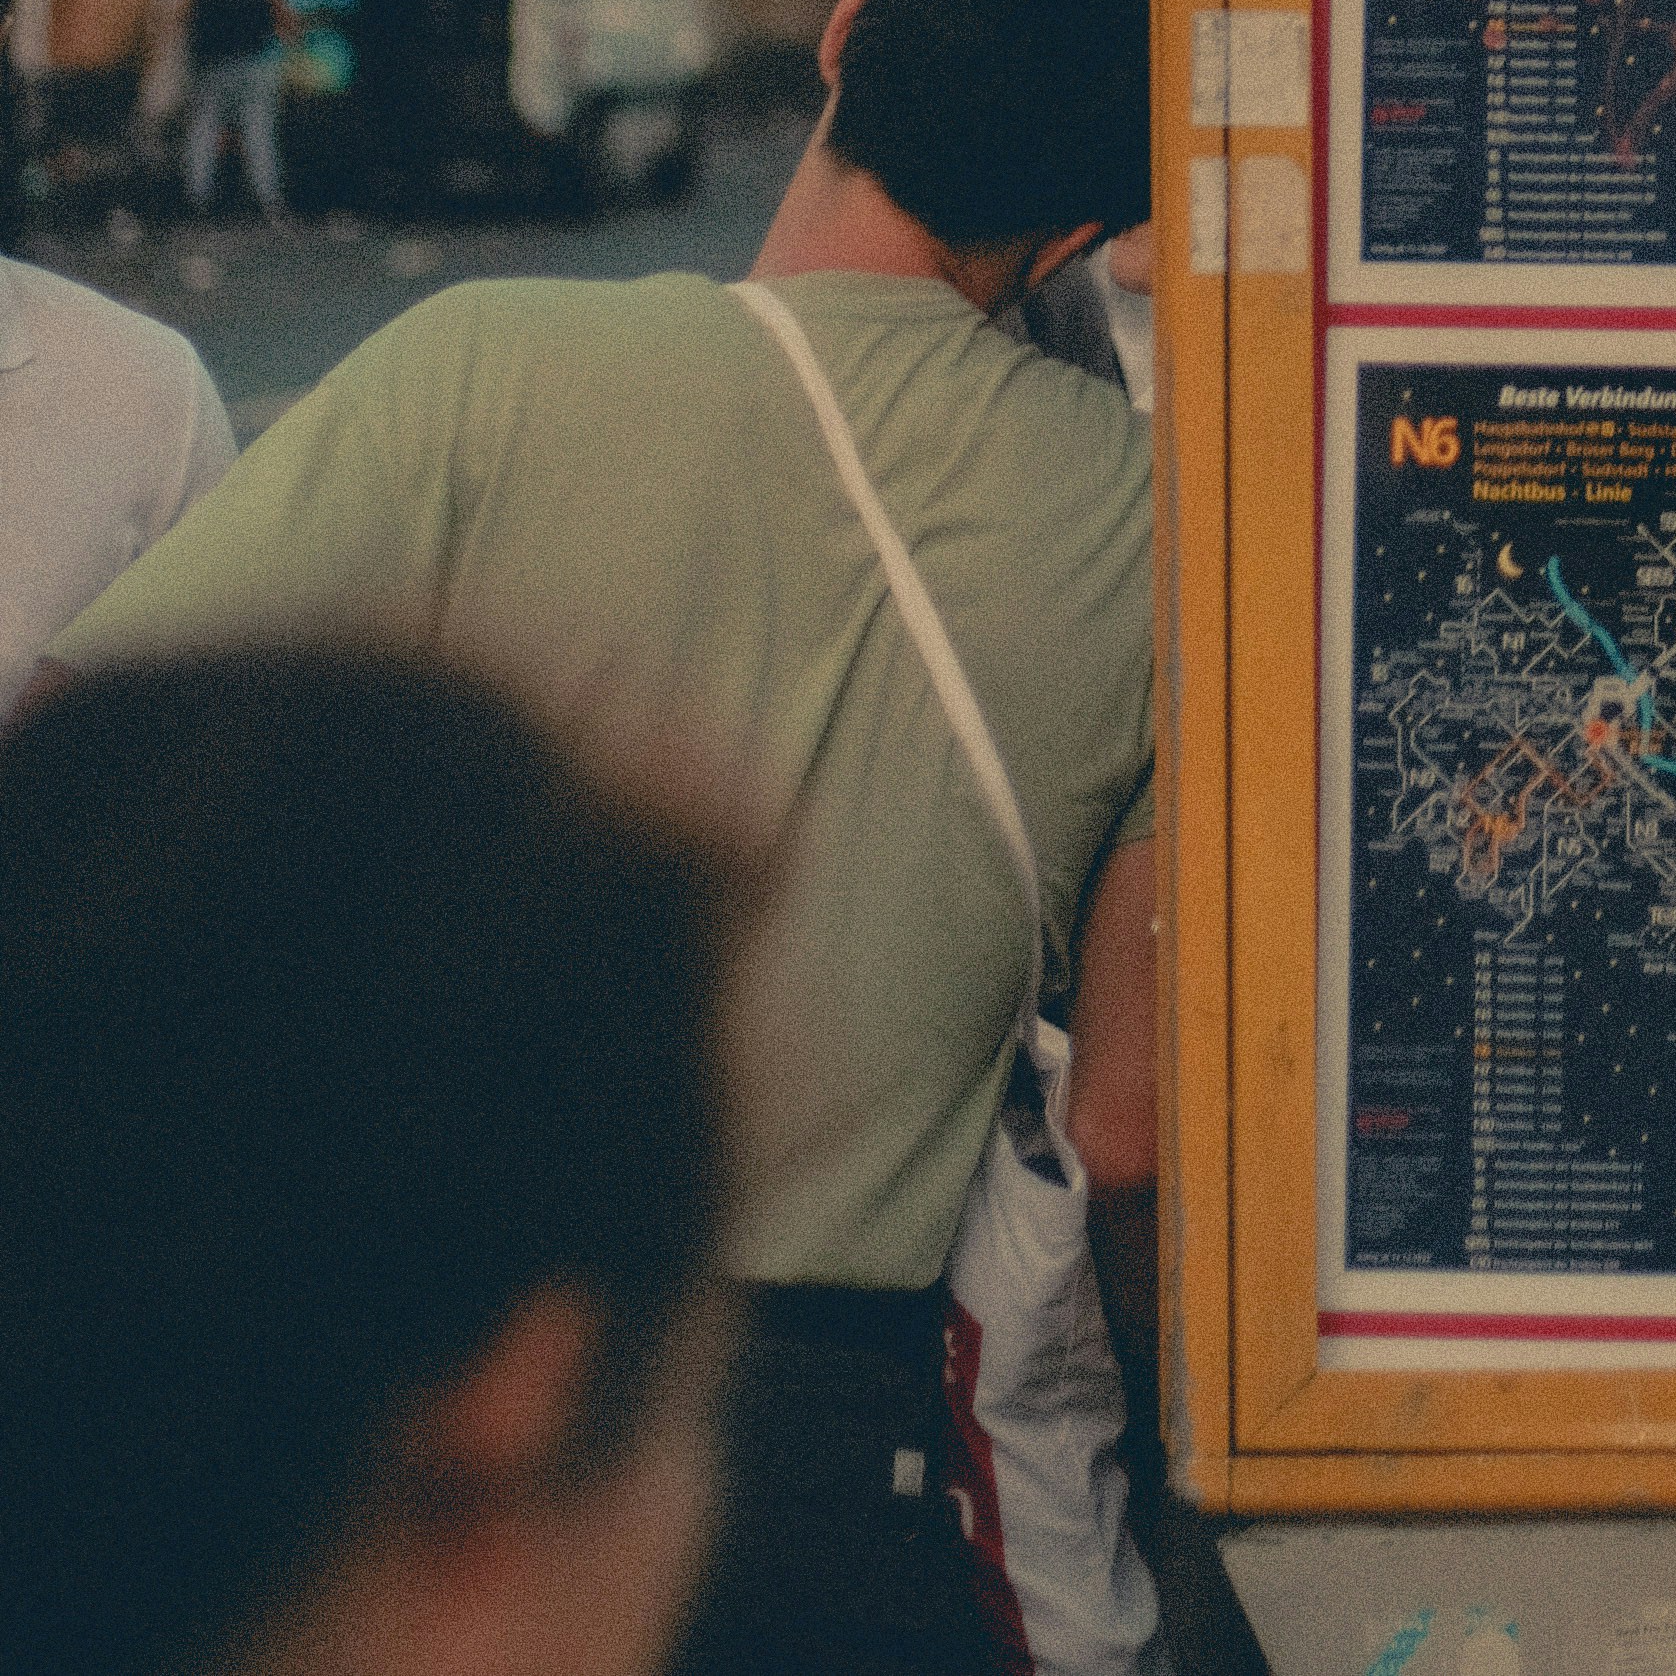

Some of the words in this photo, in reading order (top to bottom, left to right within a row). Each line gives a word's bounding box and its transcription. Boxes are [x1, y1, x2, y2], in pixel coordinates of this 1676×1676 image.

[1498, 384, 1560, 409] Beste
[1390, 416, 1461, 468] N6
[1472, 480, 1566, 503] Nachtbus
[1585, 481, 1633, 503] Linie
